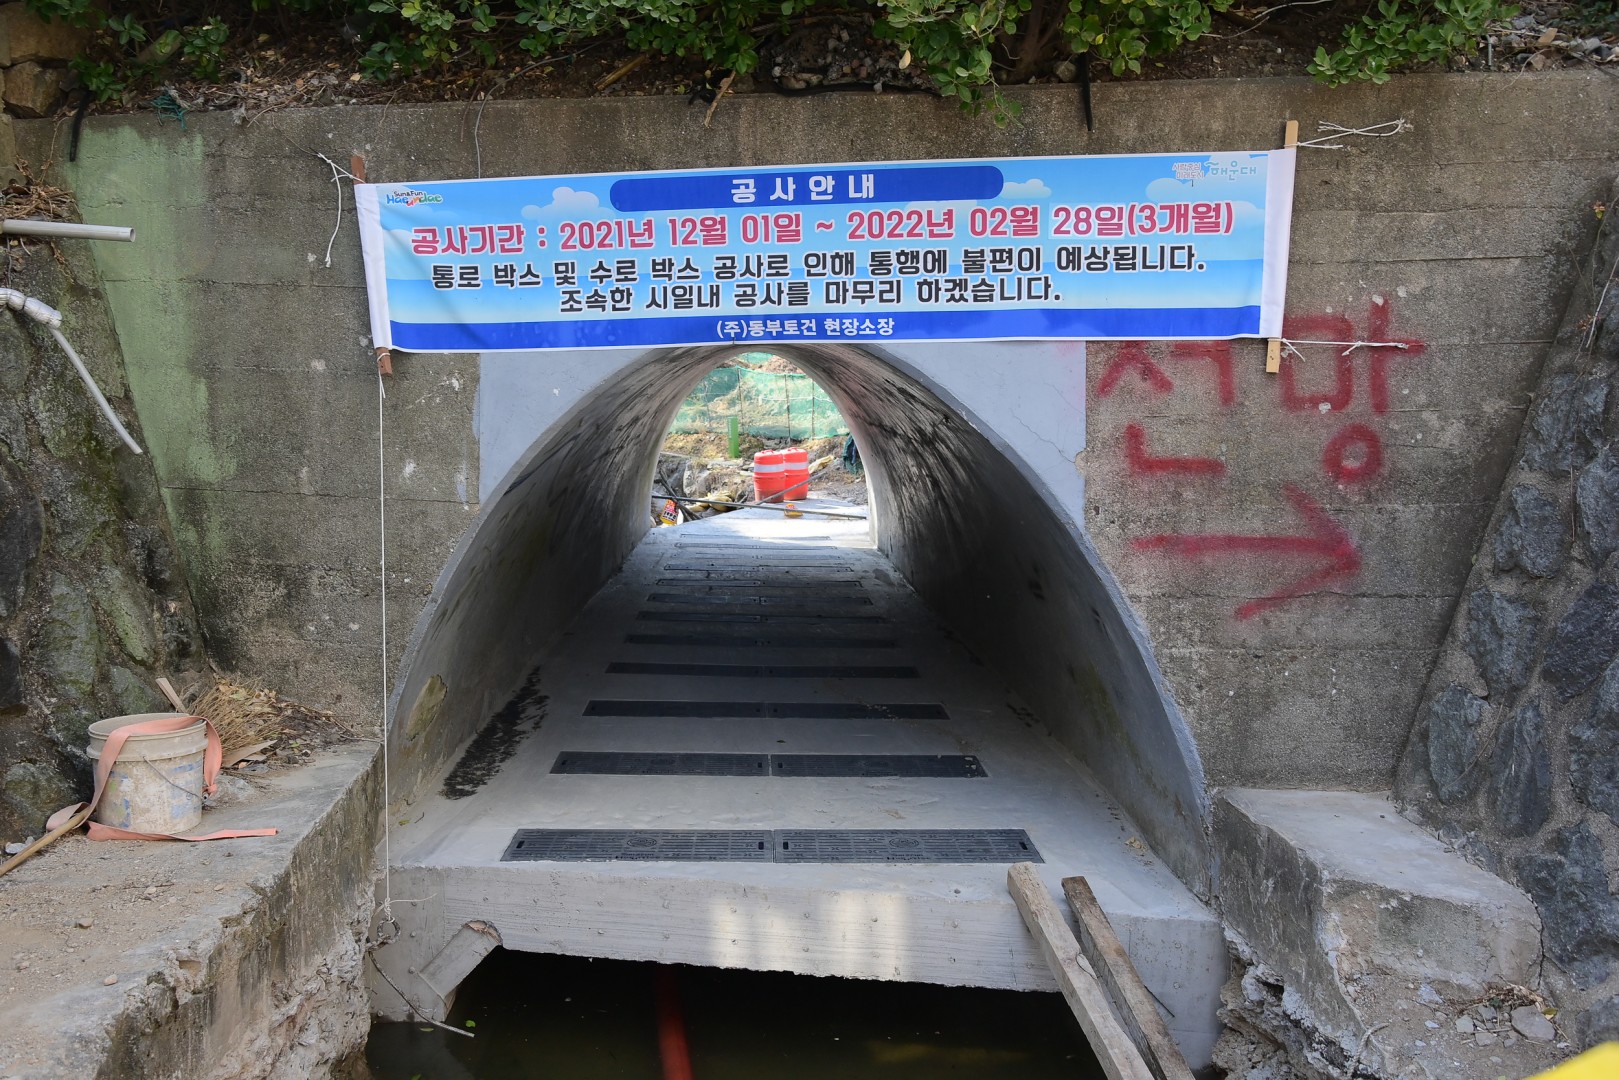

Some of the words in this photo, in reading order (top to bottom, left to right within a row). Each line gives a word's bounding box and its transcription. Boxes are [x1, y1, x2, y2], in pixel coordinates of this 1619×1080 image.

[1176, 171, 1205, 180] 미래도시
[1205, 160, 1257, 181] 해운대
[412, 224, 525, 255] 공사기간
[560, 219, 655, 250] 2021년
[668, 216, 727, 246] 12월
[741, 213, 802, 243] 01일
[848, 209, 955, 240] 2022년
[970, 206, 1040, 237] 02월
[1053, 201, 1234, 237] 28일(3개월)
[432, 264, 482, 290] 통로
[494, 263, 542, 288] 박스
[554, 261, 577, 286] 및
[590, 259, 638, 284] 수로
[651, 257, 701, 282] 박스
[713, 253, 791, 280] 공사로
[804, 251, 856, 278] 인해
[869, 249, 948, 276] 통행에
[962, 247, 1042, 274] 불편이
[1056, 244, 1205, 272] 예상됩니다.
[560, 286, 633, 313] 조속한
[645, 284, 721, 310] 시일내
[734, 281, 811, 308] 공사를
[825, 279, 902, 305] 마무리
[916, 276, 1062, 304] 하겠습니다.
[716, 318, 818, 339] (주)동부토건
[823, 314, 896, 337] 현장소장
